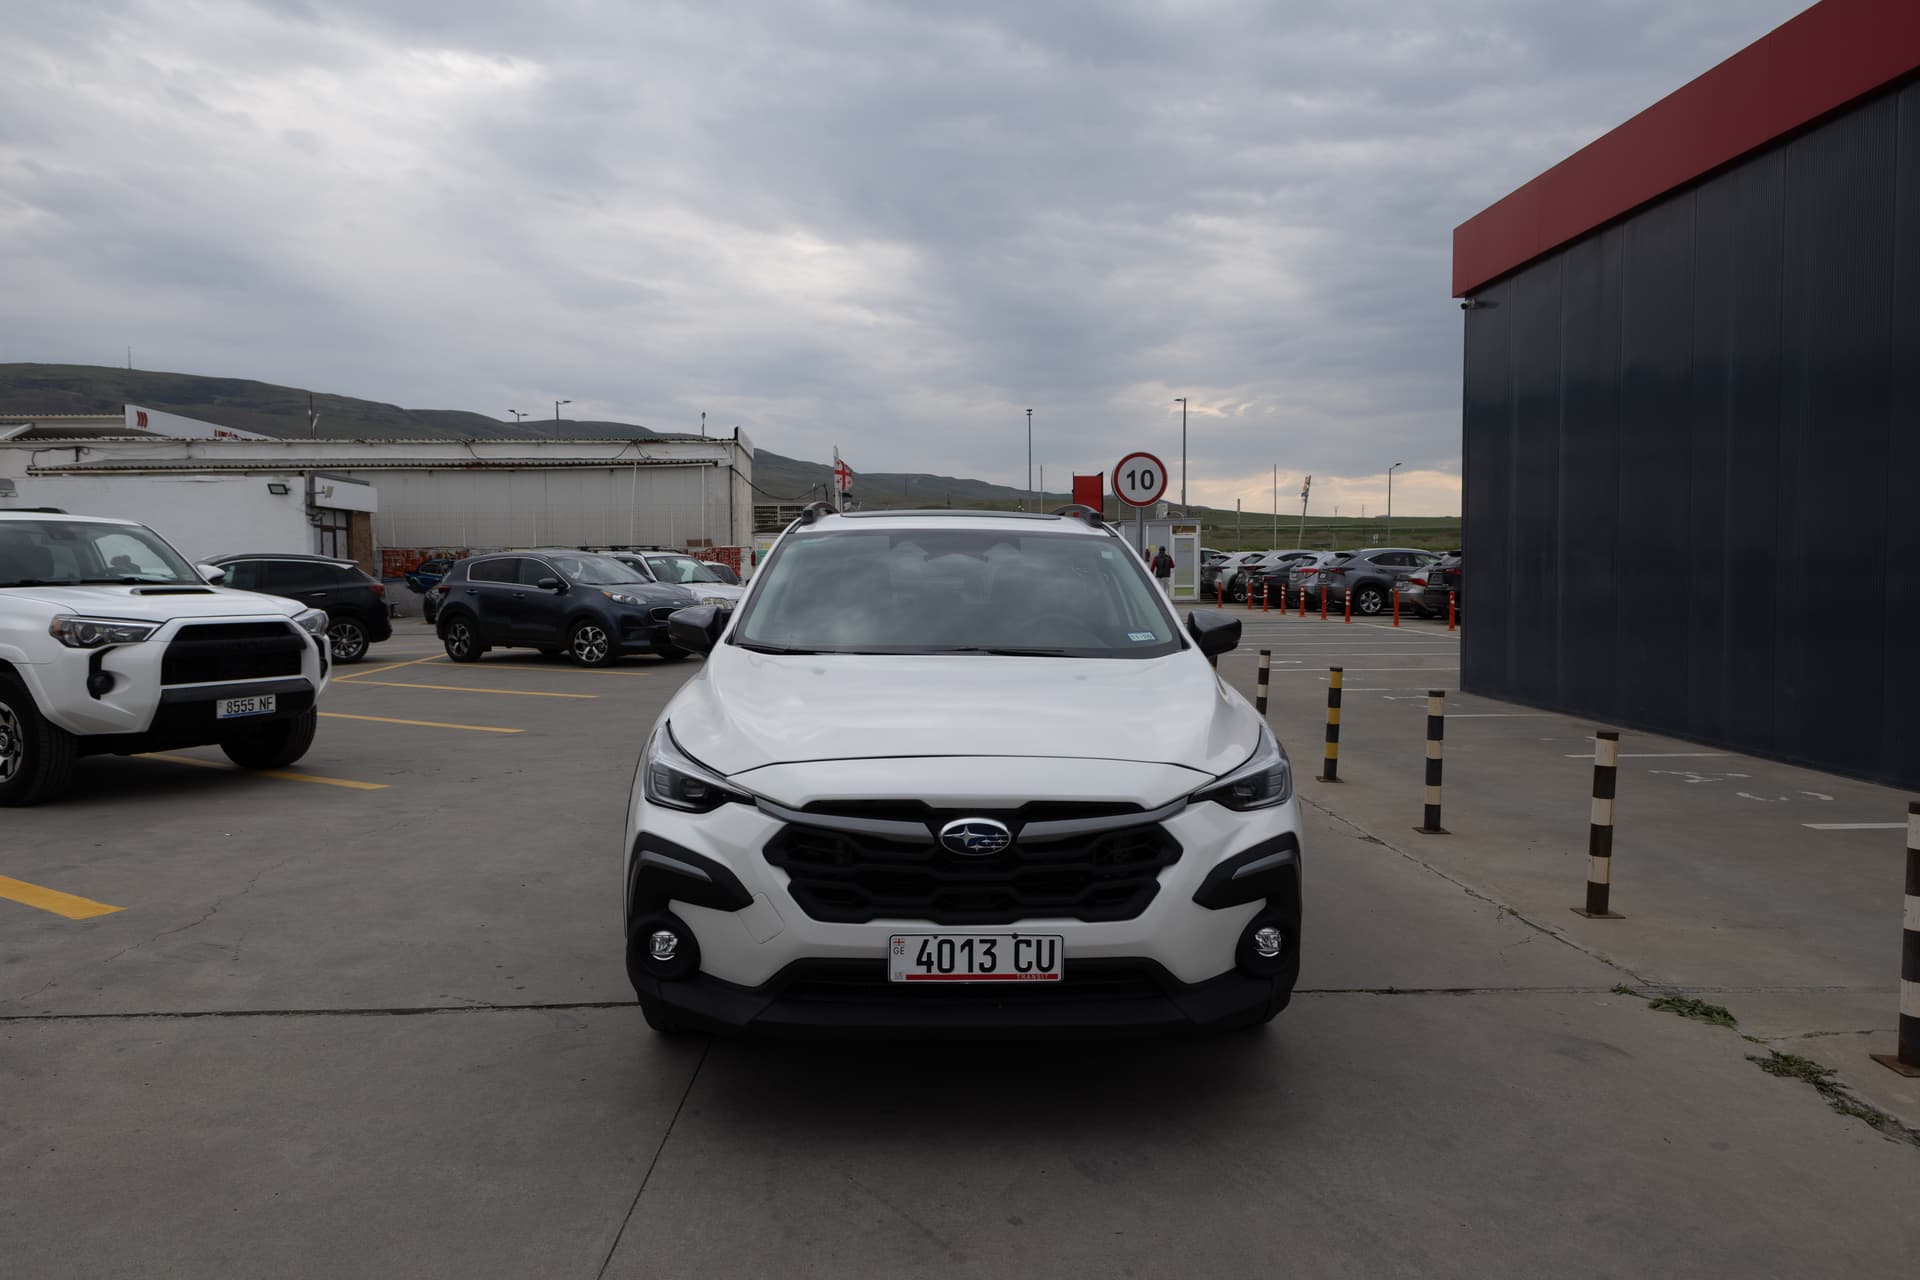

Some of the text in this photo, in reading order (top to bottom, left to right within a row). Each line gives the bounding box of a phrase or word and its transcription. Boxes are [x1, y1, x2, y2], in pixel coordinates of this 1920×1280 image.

[1126, 469, 1154, 490] 10
[226, 696, 273, 714] 8555 NF
[893, 946, 905, 955] GE
[916, 938, 1055, 974] 4013 CU
